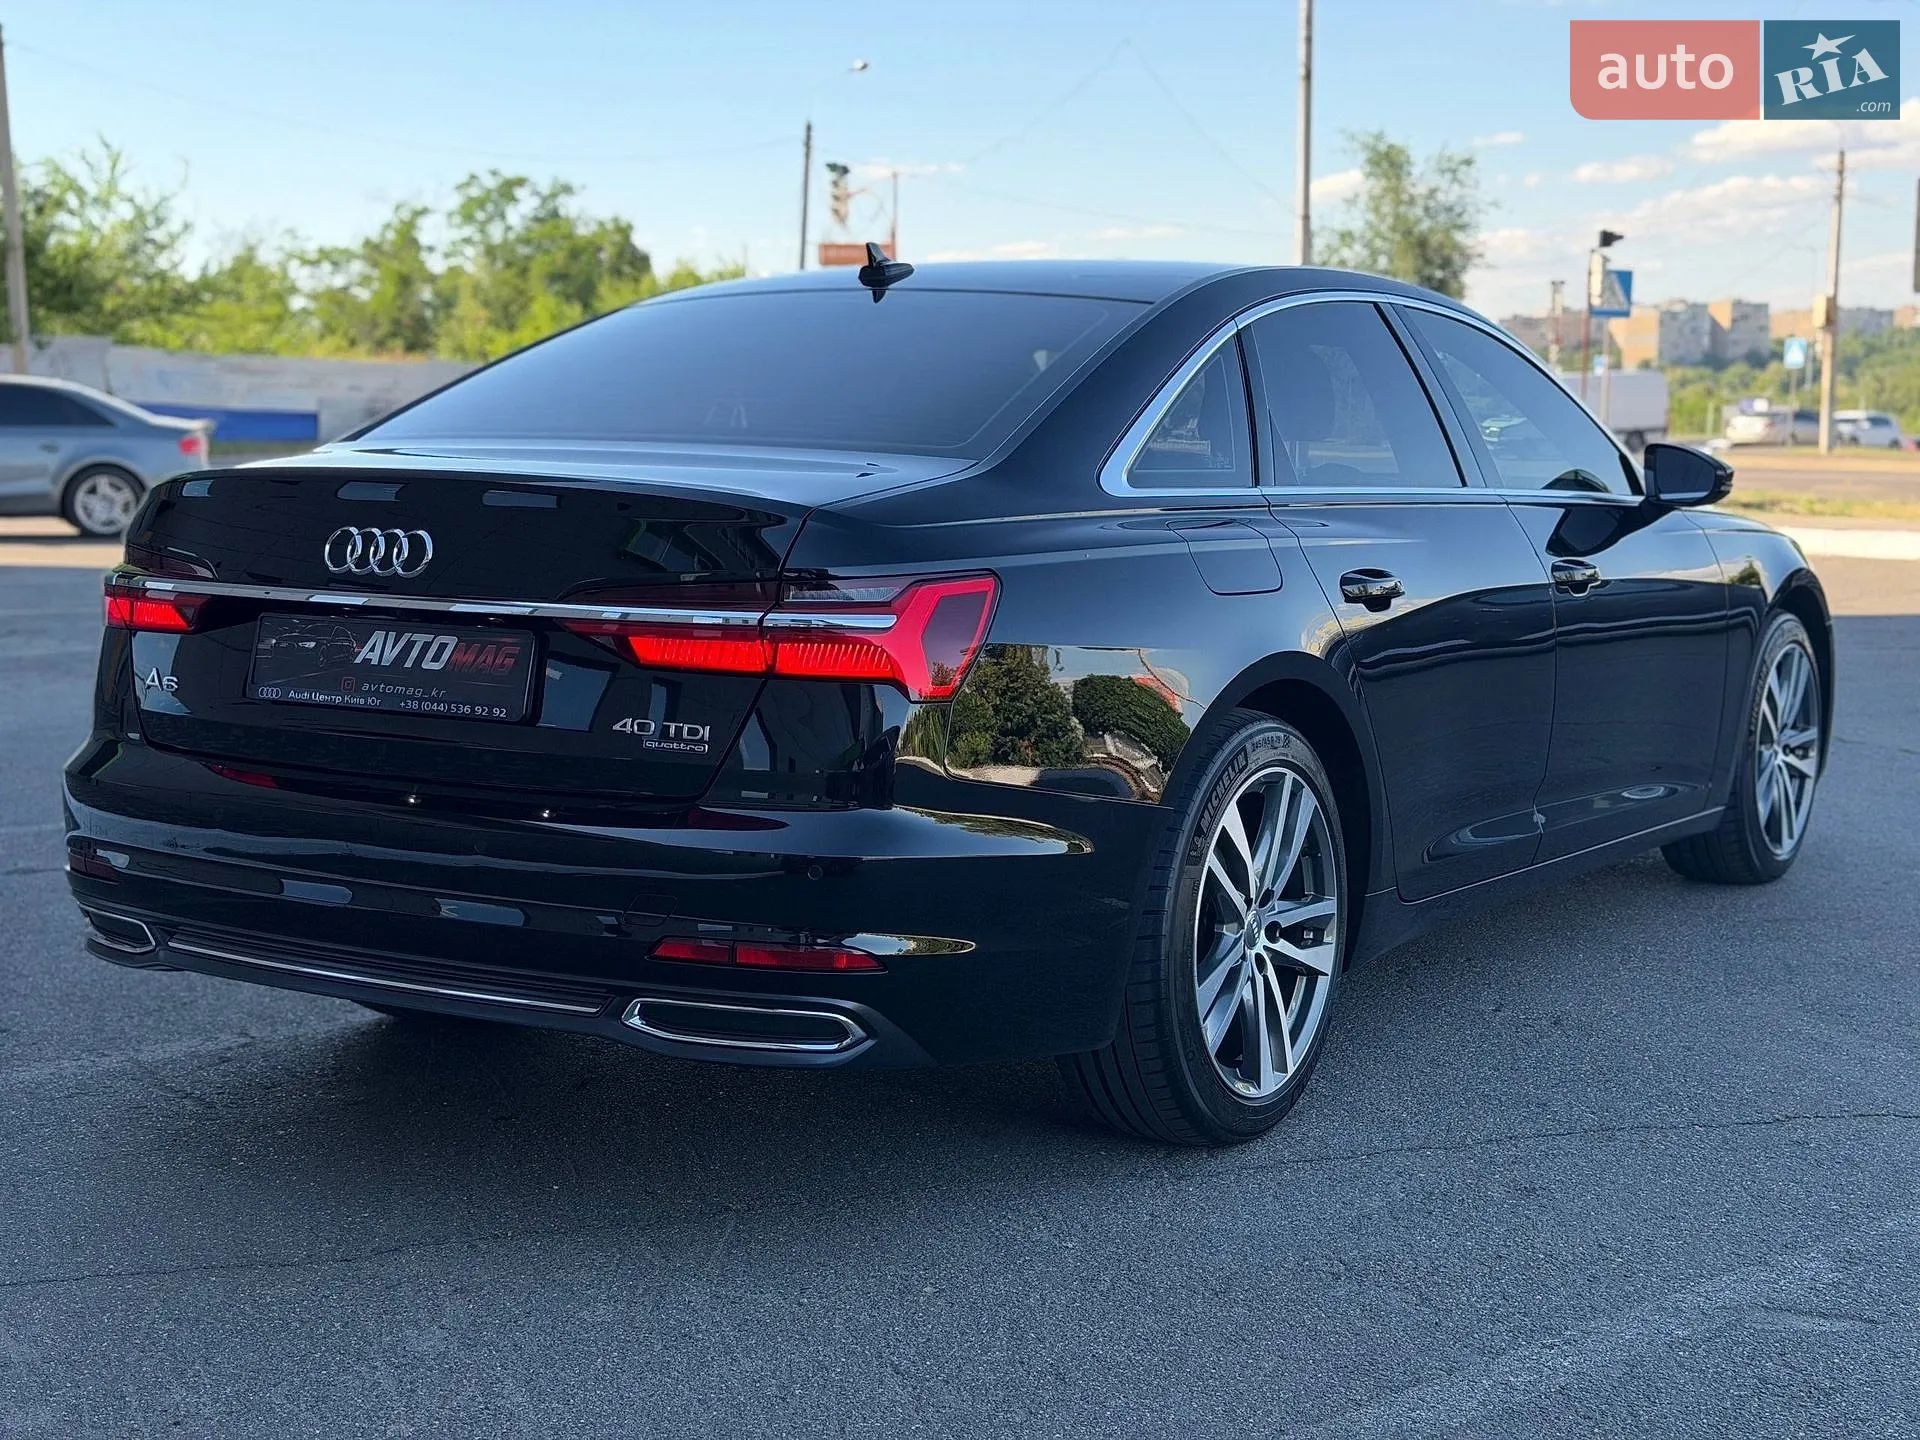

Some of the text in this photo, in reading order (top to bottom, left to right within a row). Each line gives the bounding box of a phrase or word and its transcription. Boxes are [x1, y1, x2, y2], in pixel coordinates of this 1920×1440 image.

[145, 667, 179, 692] A6
[361, 682, 447, 698] avtomag_kr
[288, 690, 310, 700] Audi
[312, 692, 342, 704] Центр
[367, 697, 382, 706] Юг
[400, 700, 419, 710] +38
[421, 701, 448, 713] (044)
[450, 704, 471, 714] 536
[474, 706, 489, 716] 92
[492, 707, 507, 718] 92
[612, 718, 711, 742] 40 TDI
[645, 741, 705, 753] quattro
[1200, 749, 1248, 833] MICHELIN
